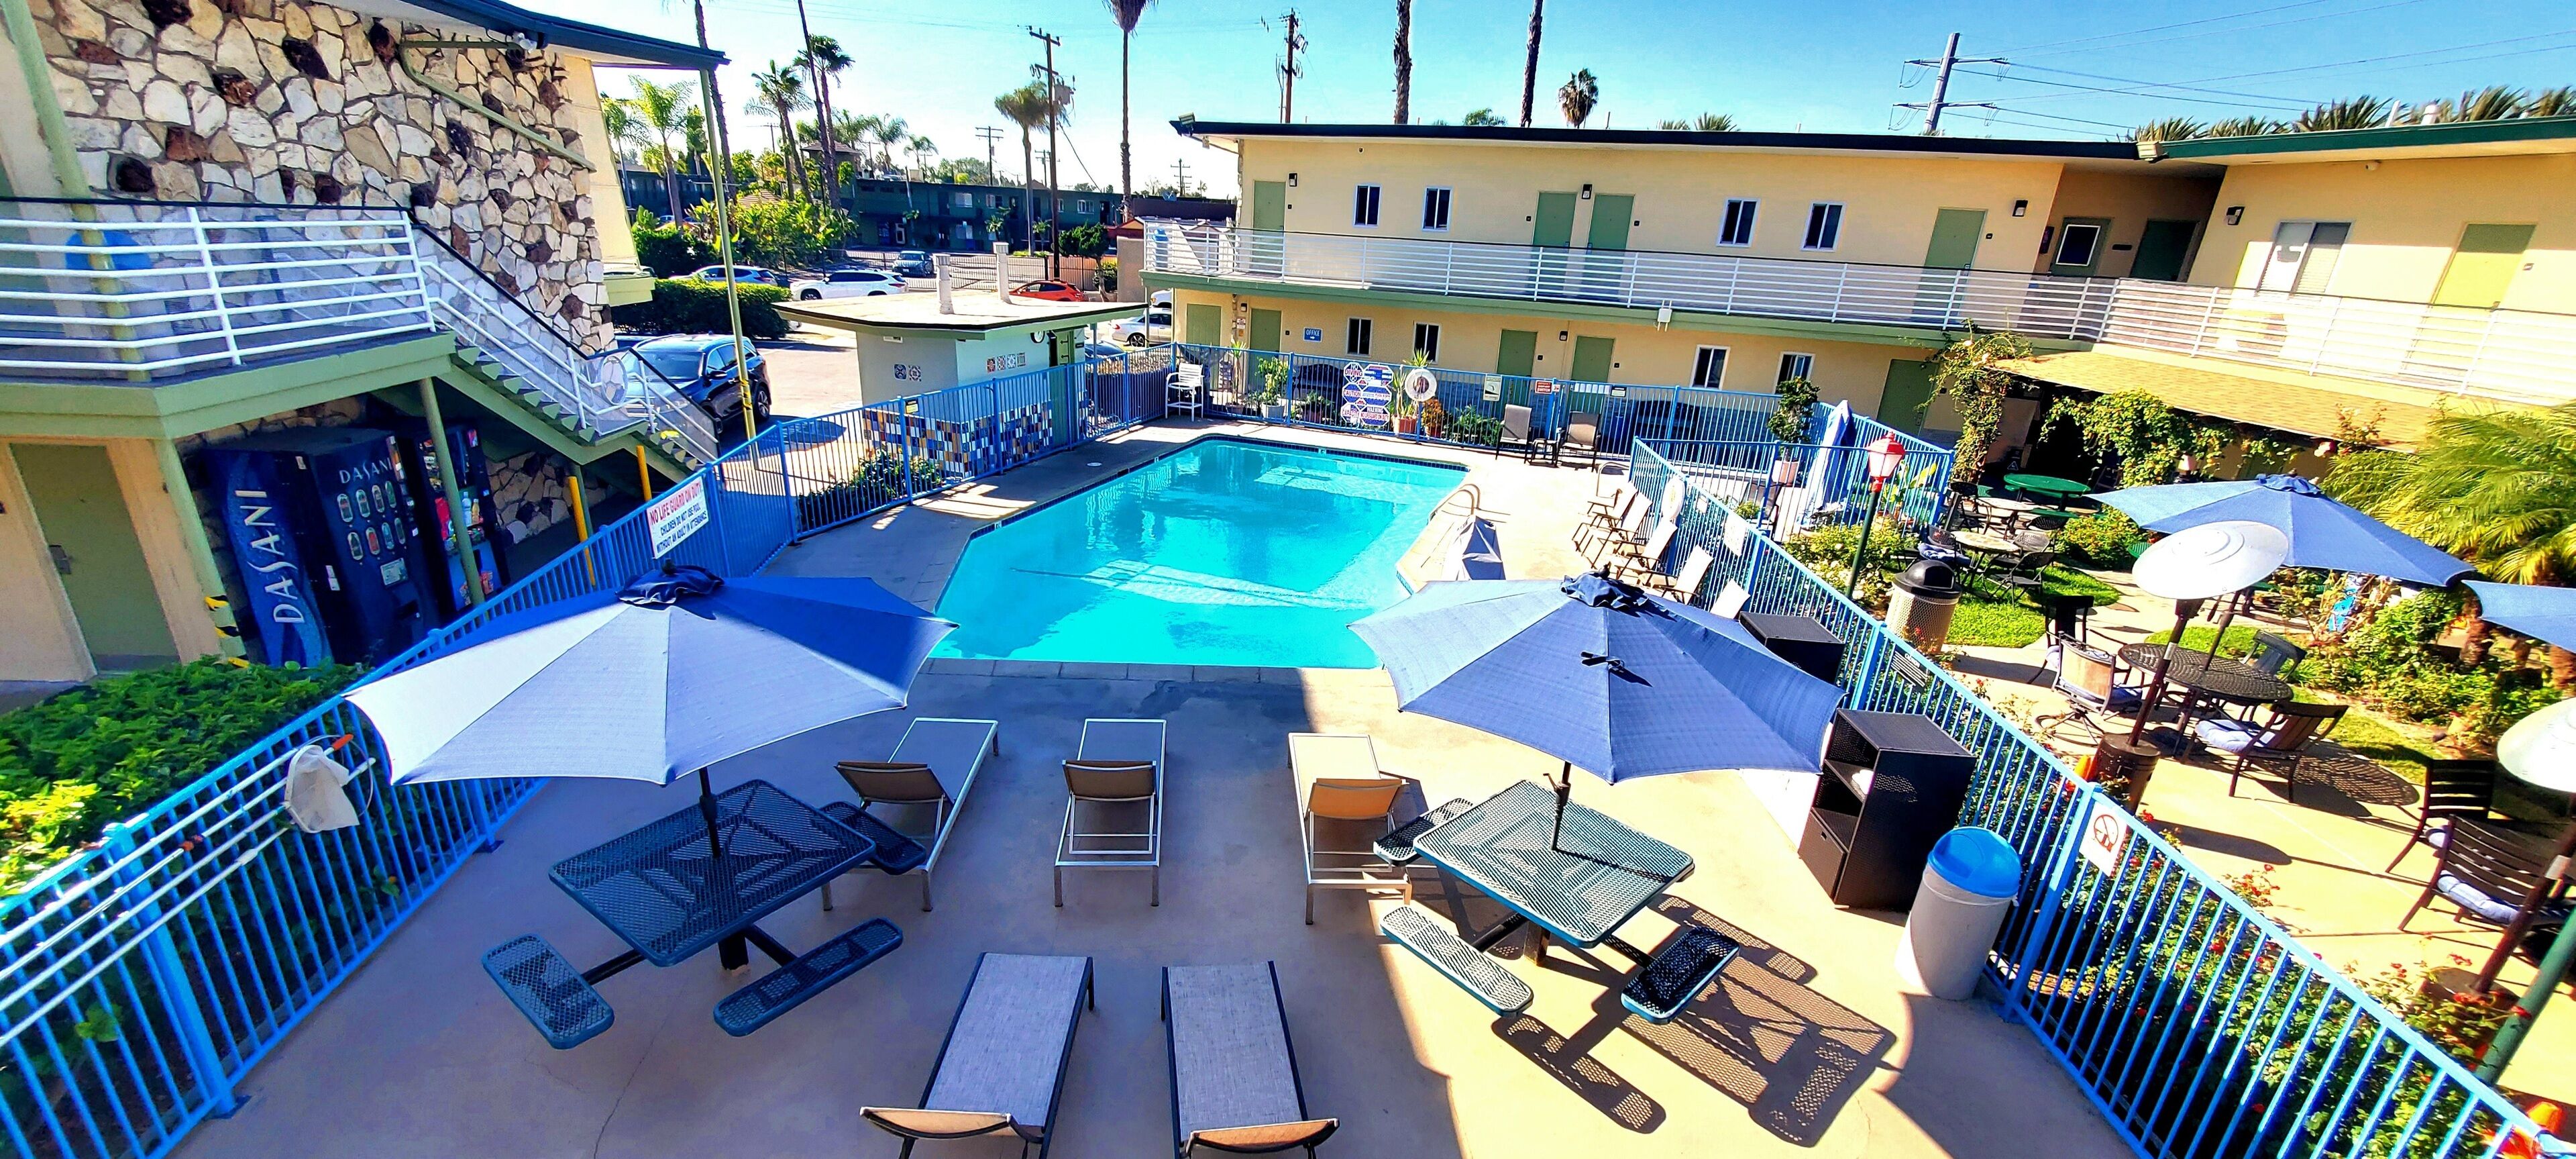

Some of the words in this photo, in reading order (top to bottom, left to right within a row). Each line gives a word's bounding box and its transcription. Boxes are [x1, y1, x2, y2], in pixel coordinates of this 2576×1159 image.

[339, 457, 392, 484] DASANI
[650, 509, 658, 525] NO
[658, 502, 669, 521] LIFE
[669, 493, 685, 513] GUARD
[684, 490, 692, 503] ON
[235, 490, 305, 623] DASANI
